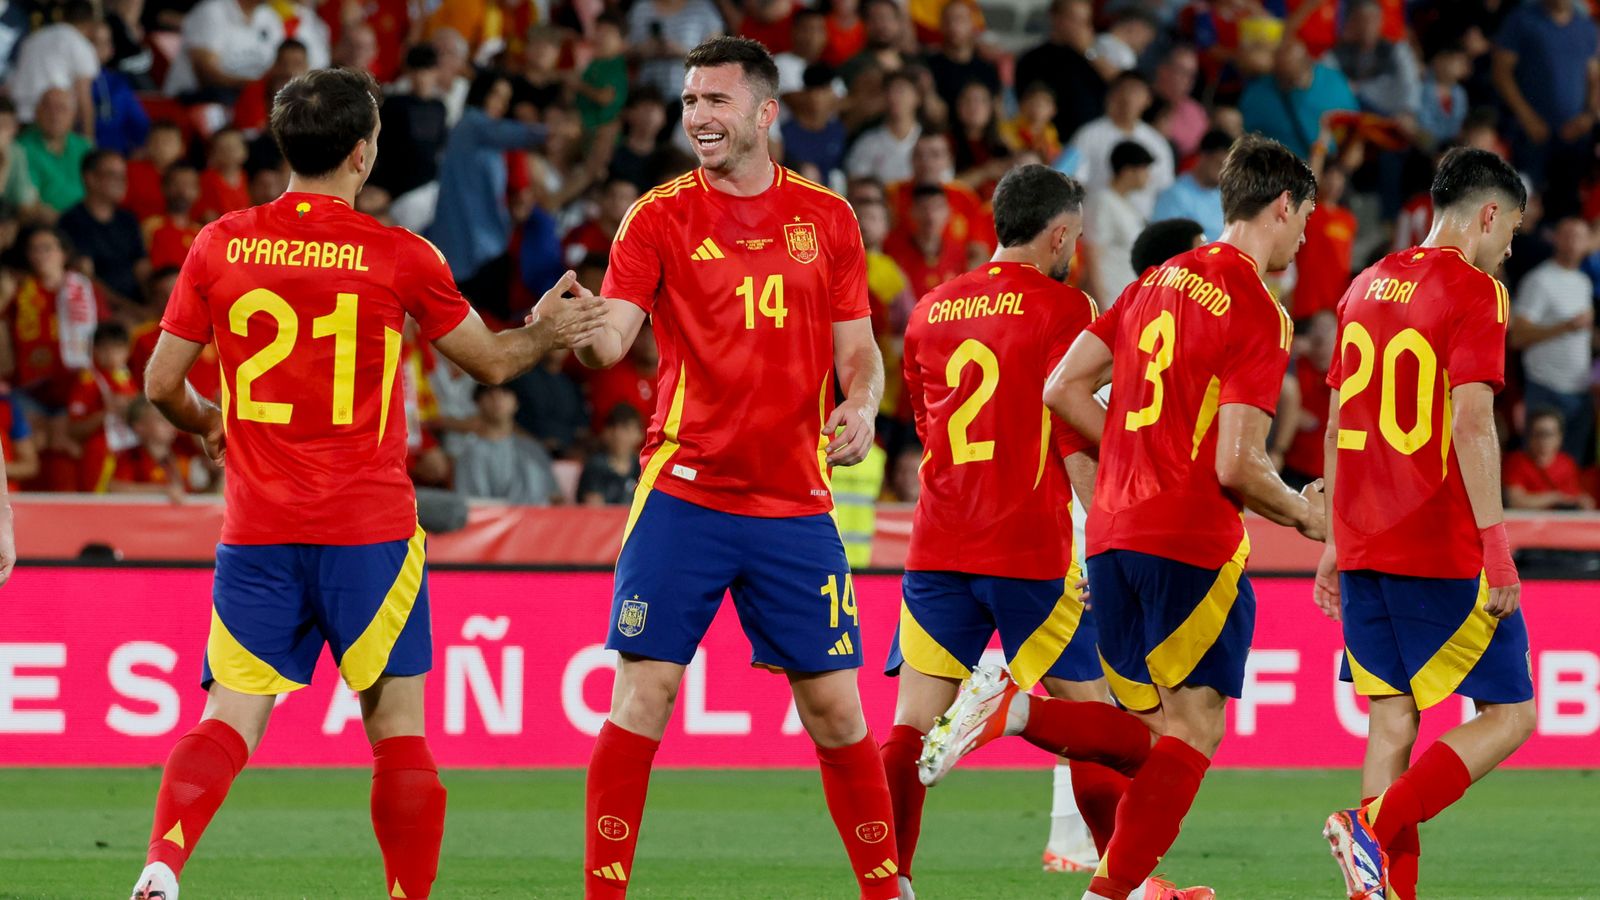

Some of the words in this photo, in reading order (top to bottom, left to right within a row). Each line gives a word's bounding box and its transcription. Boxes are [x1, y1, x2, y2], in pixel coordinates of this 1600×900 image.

[226, 237, 369, 271] OYARZABAL
[1364, 277, 1418, 303] PEDRI
[735, 274, 788, 330] 14
[928, 292, 1025, 324] CARVAJAL
[228, 287, 358, 425] 21
[1125, 309, 1175, 432] 3
[1337, 321, 1437, 455] 20
[945, 338, 1000, 465] 2
[820, 573, 858, 628] 14
[0, 614, 806, 737] ESÑOL
